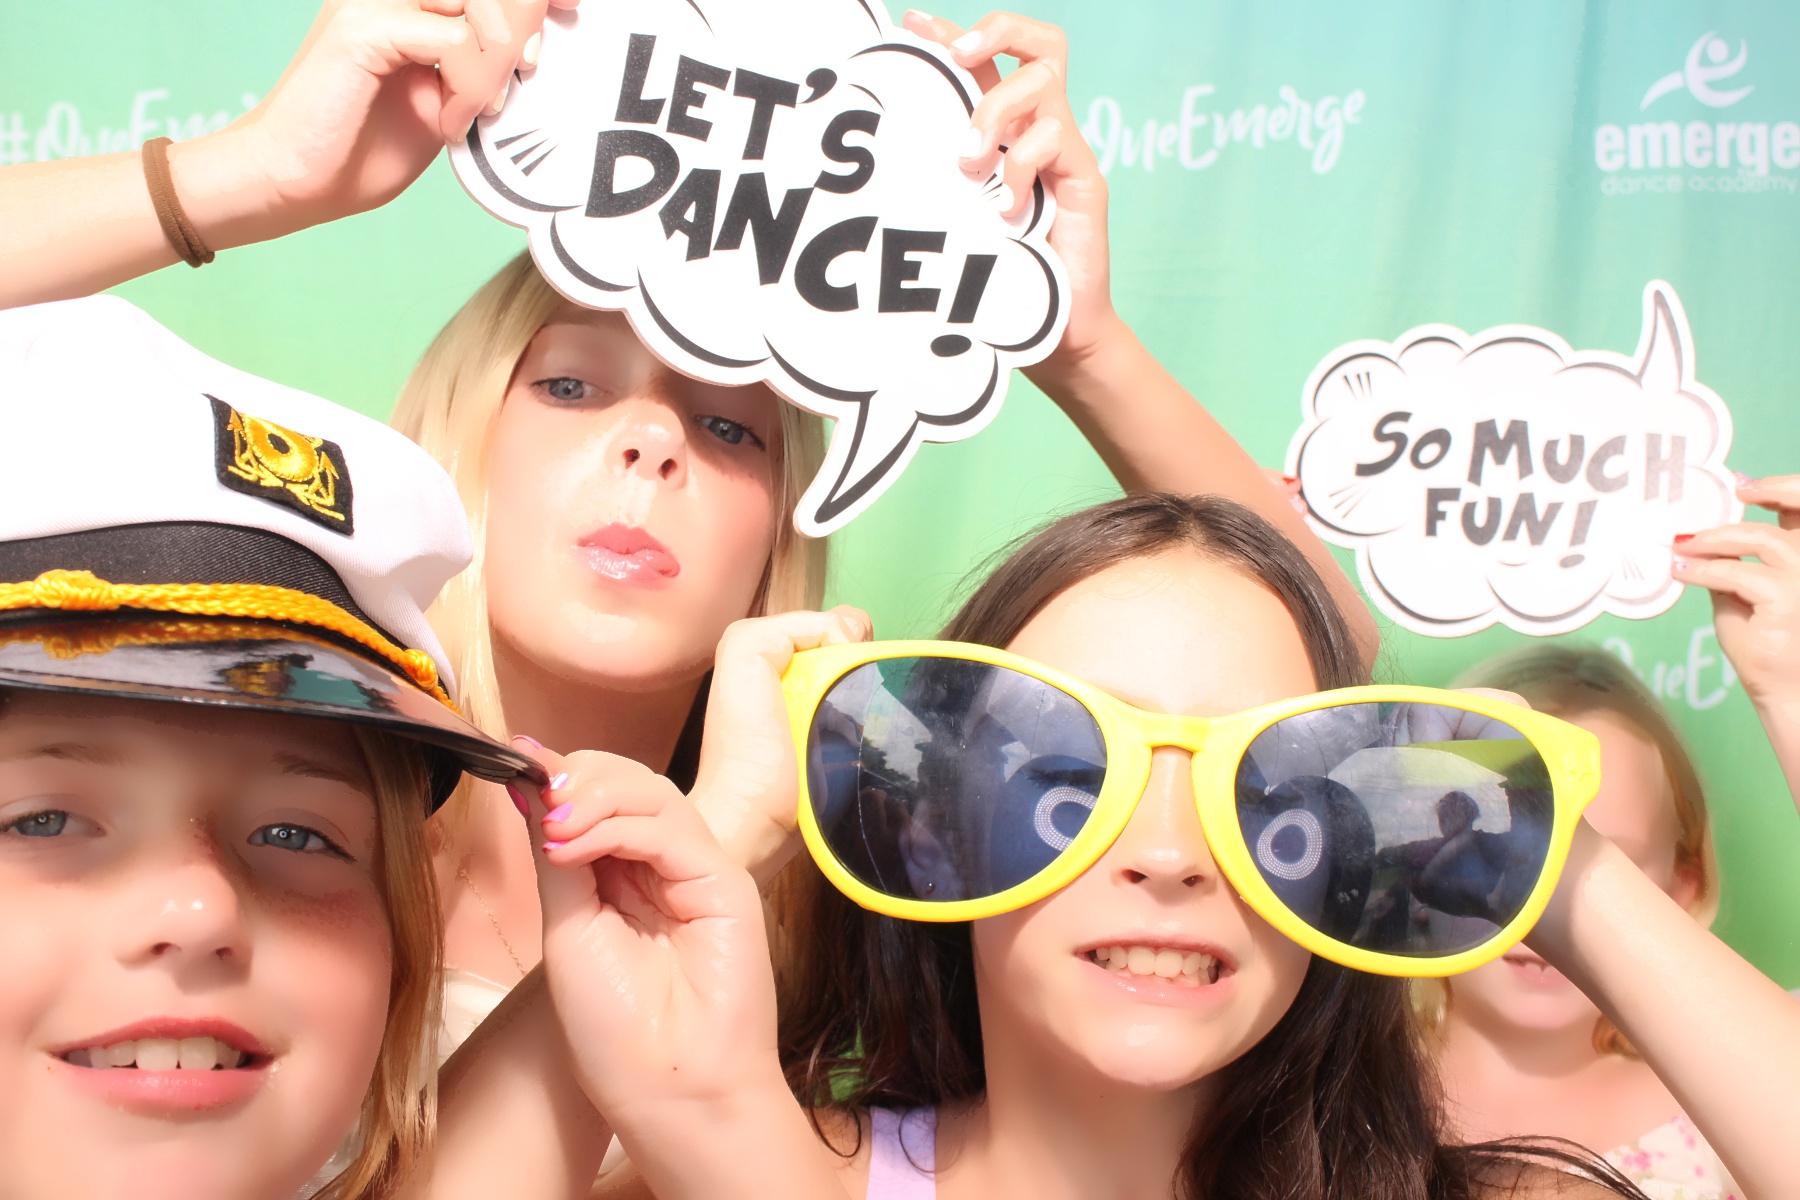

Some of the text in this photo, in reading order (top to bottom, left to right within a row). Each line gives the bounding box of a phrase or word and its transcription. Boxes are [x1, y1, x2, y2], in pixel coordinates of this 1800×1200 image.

[615, 33, 881, 194] LET'S
[1595, 119, 1800, 176] emerge
[1600, 166, 1798, 196] dance academy
[585, 129, 998, 358] DANCE!
[1467, 418, 1687, 504] MUCH
[1425, 487, 1599, 569] FUN!
